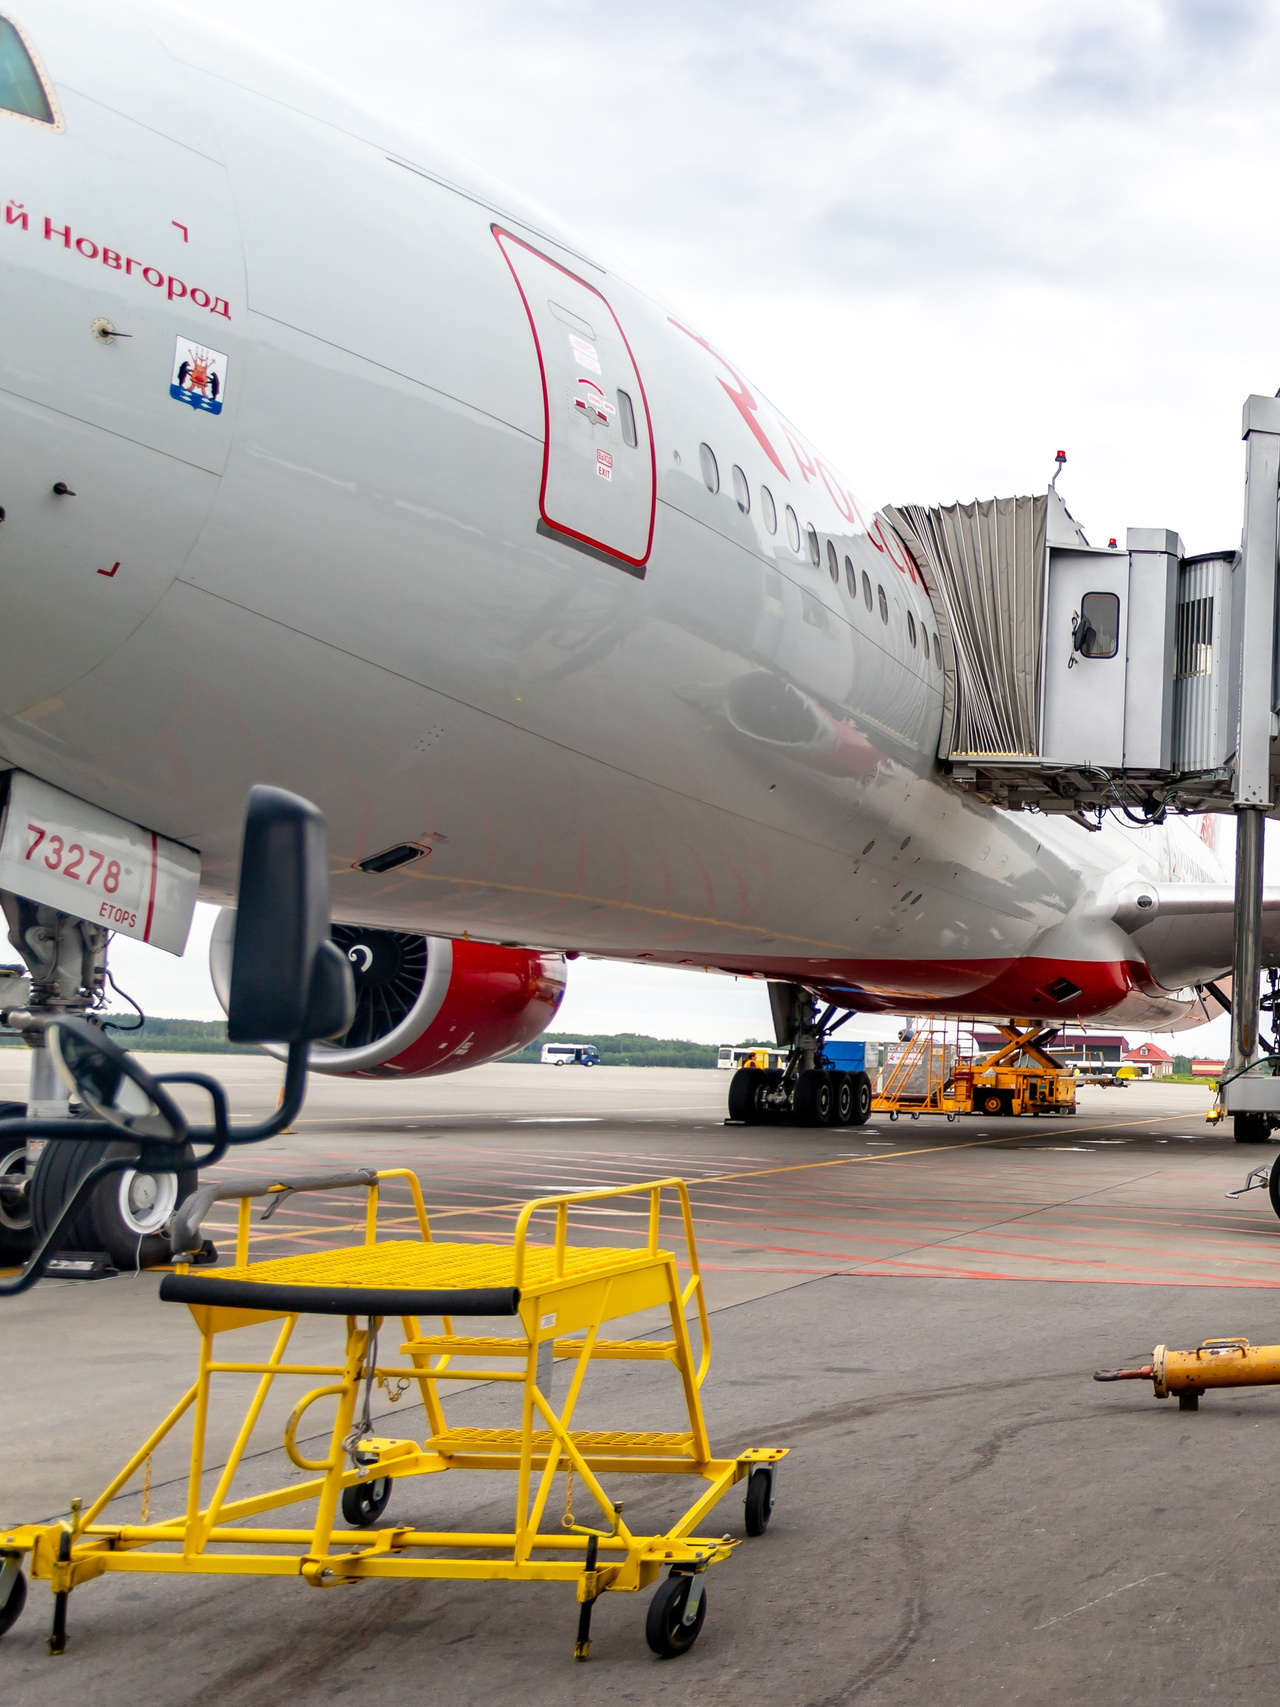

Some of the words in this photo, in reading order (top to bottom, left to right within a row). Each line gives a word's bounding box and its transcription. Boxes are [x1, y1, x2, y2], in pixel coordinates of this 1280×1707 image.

[1, 198, 30, 232] й
[43, 216, 232, 322] Новгород
[598, 465, 610, 480] EXIT
[25, 823, 122, 894] 73278
[99, 902, 138, 929] ETOPS
